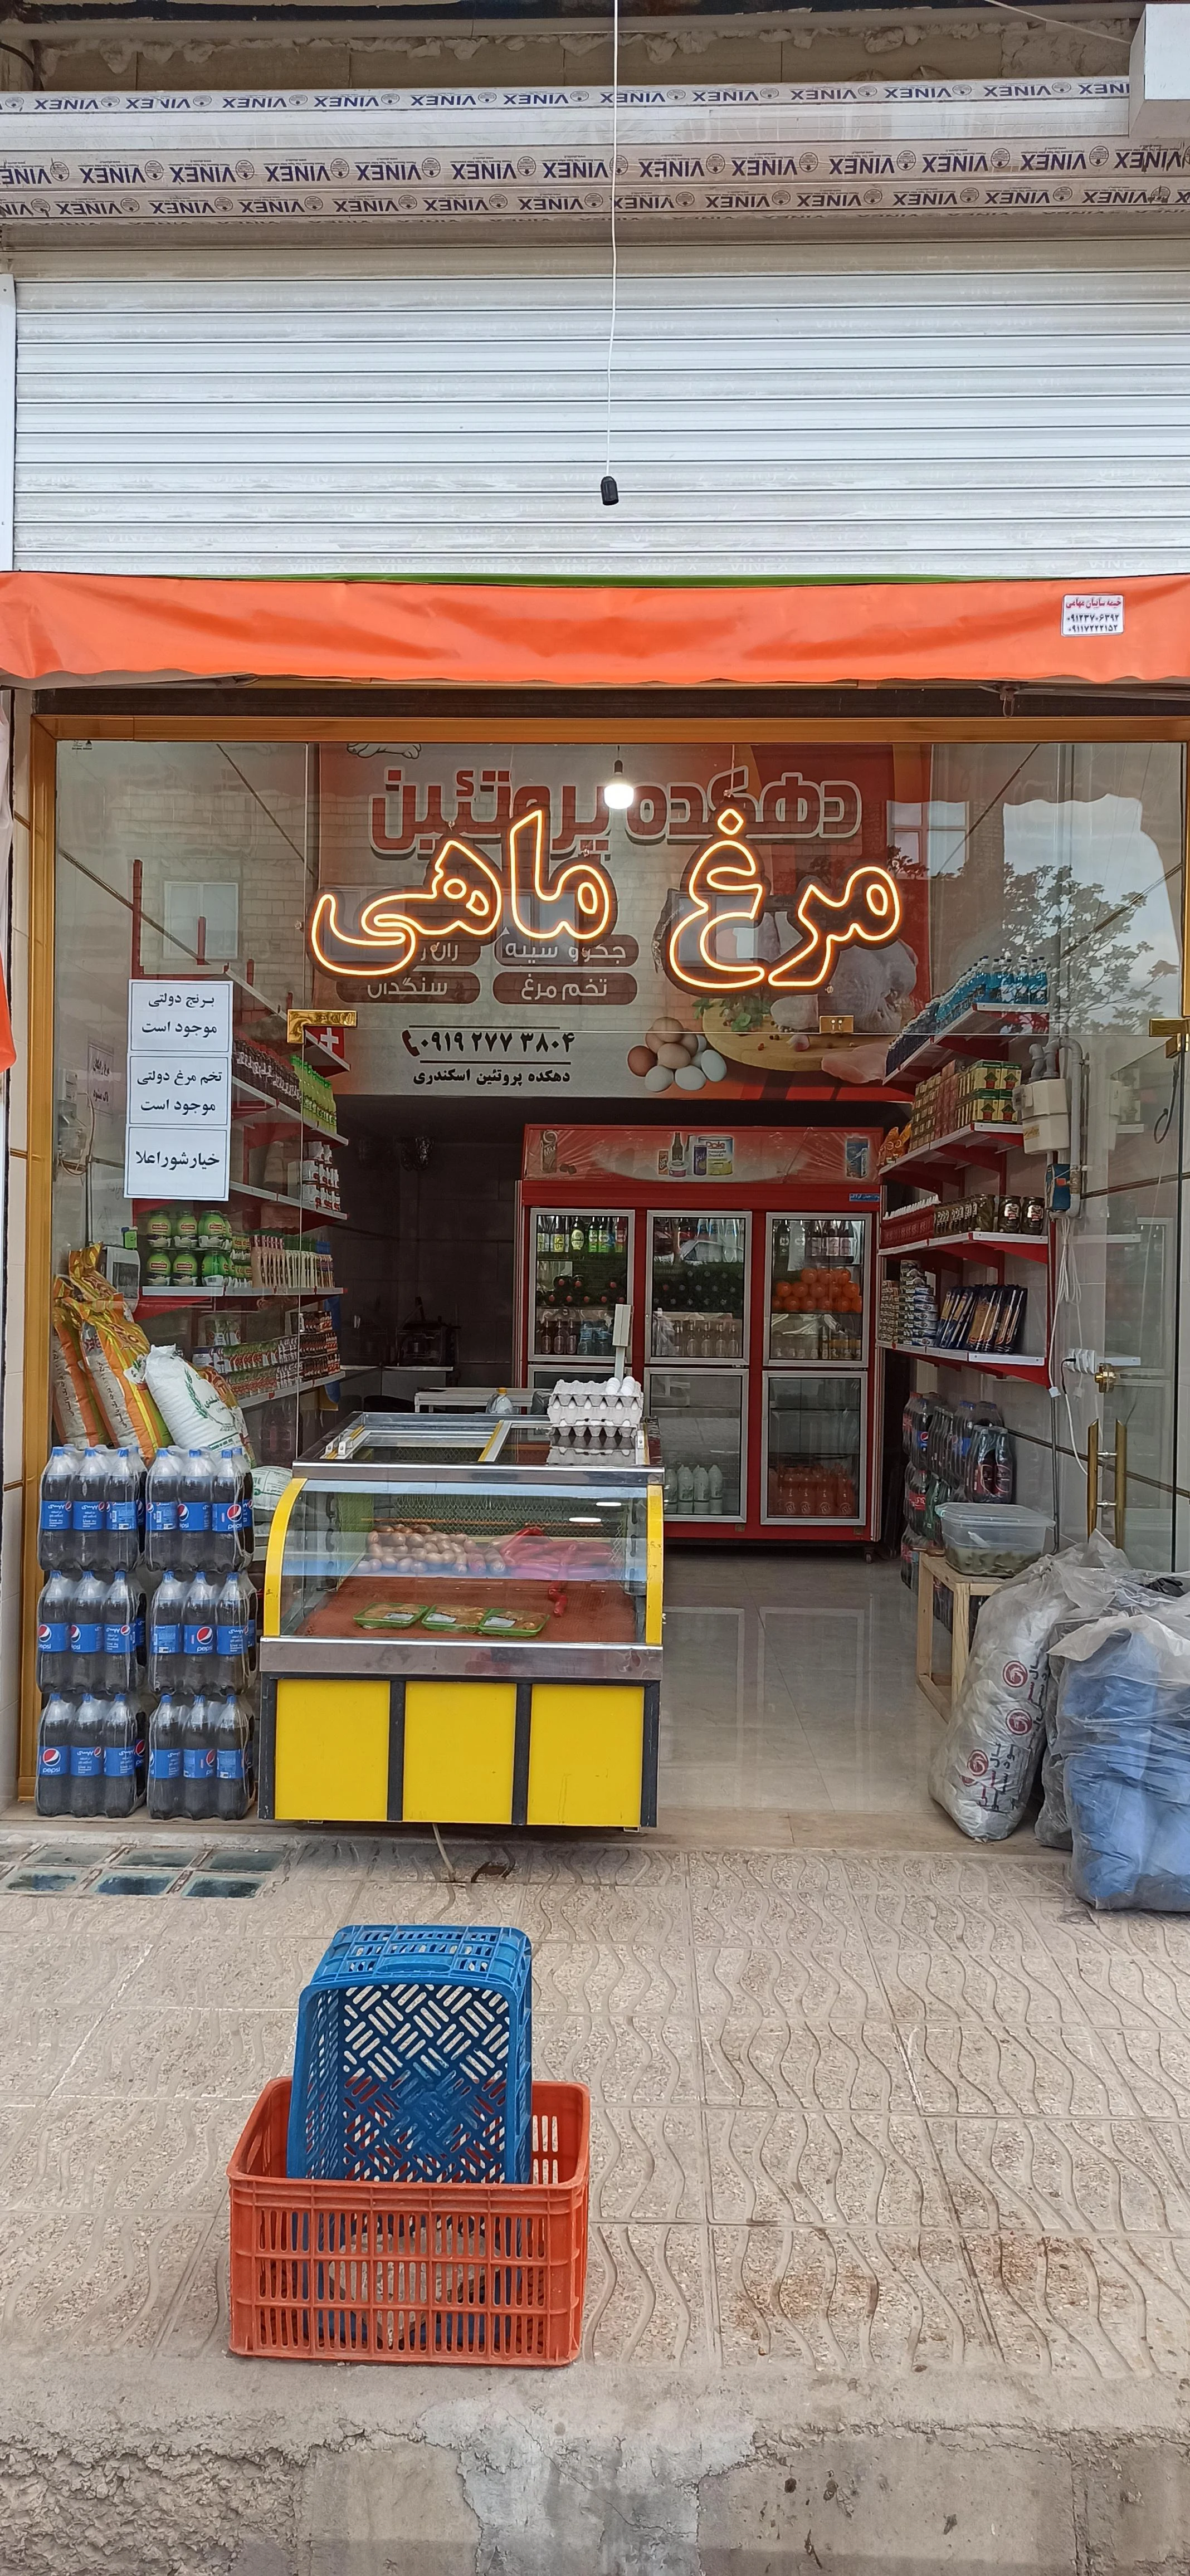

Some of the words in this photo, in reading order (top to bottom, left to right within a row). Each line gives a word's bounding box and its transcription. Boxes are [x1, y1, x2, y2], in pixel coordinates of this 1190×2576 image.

[35, 99, 99, 110] VINEX
[222, 96, 287, 108] VINEX
[314, 95, 379, 107] VINEX
[411, 94, 476, 106] VINEX
[503, 93, 569, 105] VINEX
[600, 92, 665, 104] VINEX
[692, 91, 759, 103] VINEX
[791, 90, 857, 101] VINEX
[884, 88, 952, 100] VINEX
[983, 86, 1051, 97] VINEX
[1078, 84, 1130, 95] INEX
[2, 168, 52, 186] VINE
[82, 167, 146, 184] VINEX
[171, 167, 236, 184] VINEX
[266, 165, 330, 183] VINEX
[357, 164, 422, 182] VINEX
[452, 163, 517, 180] VINEX
[543, 162, 608, 179] VINEX
[639, 160, 704, 178] VINEX
[731, 159, 797, 176] VINEX
[829, 157, 895, 174] VINEX
[921, 155, 988, 173] VINEX
[1021, 153, 1086, 170] VINEX
[1114, 151, 1182, 168] VINEX
[58, 203, 123, 215] VINEX
[149, 202, 216, 214] VINEX
[240, 201, 305, 213] VINEX
[334, 200, 399, 212] VINEX
[424, 199, 489, 211] VINEX
[518, 198, 584, 211] VINEX
[611, 197, 675, 209] VINEX
[705, 196, 770, 208] VINEX
[797, 194, 862, 207] VINEX
[892, 193, 957, 205] VINEX
[984, 192, 1050, 204] VINEX
[1082, 191, 1148, 203] VINEX
[1086, 597, 1105, 609] سایبان
[1067, 613, 1119, 622] ۰۹۱۲۳۷۰۶۳۹۲
[626, 765, 862, 840] دهکده
[311, 808, 611, 978] ماهی
[669, 808, 901, 989] مرغ
[367, 977, 448, 999] سنگدان
[521, 973, 557, 1001] مرغ
[562, 978, 607, 1001] تخم
[148, 992, 182, 1007] دولتی
[186, 994, 214, 1008] برنج
[142, 1021, 170, 1033] است
[175, 1023, 217, 1038] موجود
[421, 1031, 464, 1052] ۰۹۱۹
[471, 1032, 513, 1052] ۲۷۷
[520, 1032, 576, 1052] ۳۸۰۴
[136, 1070, 170, 1085] دولتی
[174, 1070, 197, 1086] مرغ
[200, 1071, 222, 1086] تخم
[413, 1068, 470, 1085] اسکندری
[476, 1068, 523, 1086] پروتئین
[528, 1069, 570, 1082] دهکده
[140, 1099, 169, 1111] است
[174, 1100, 216, 1116] موجود
